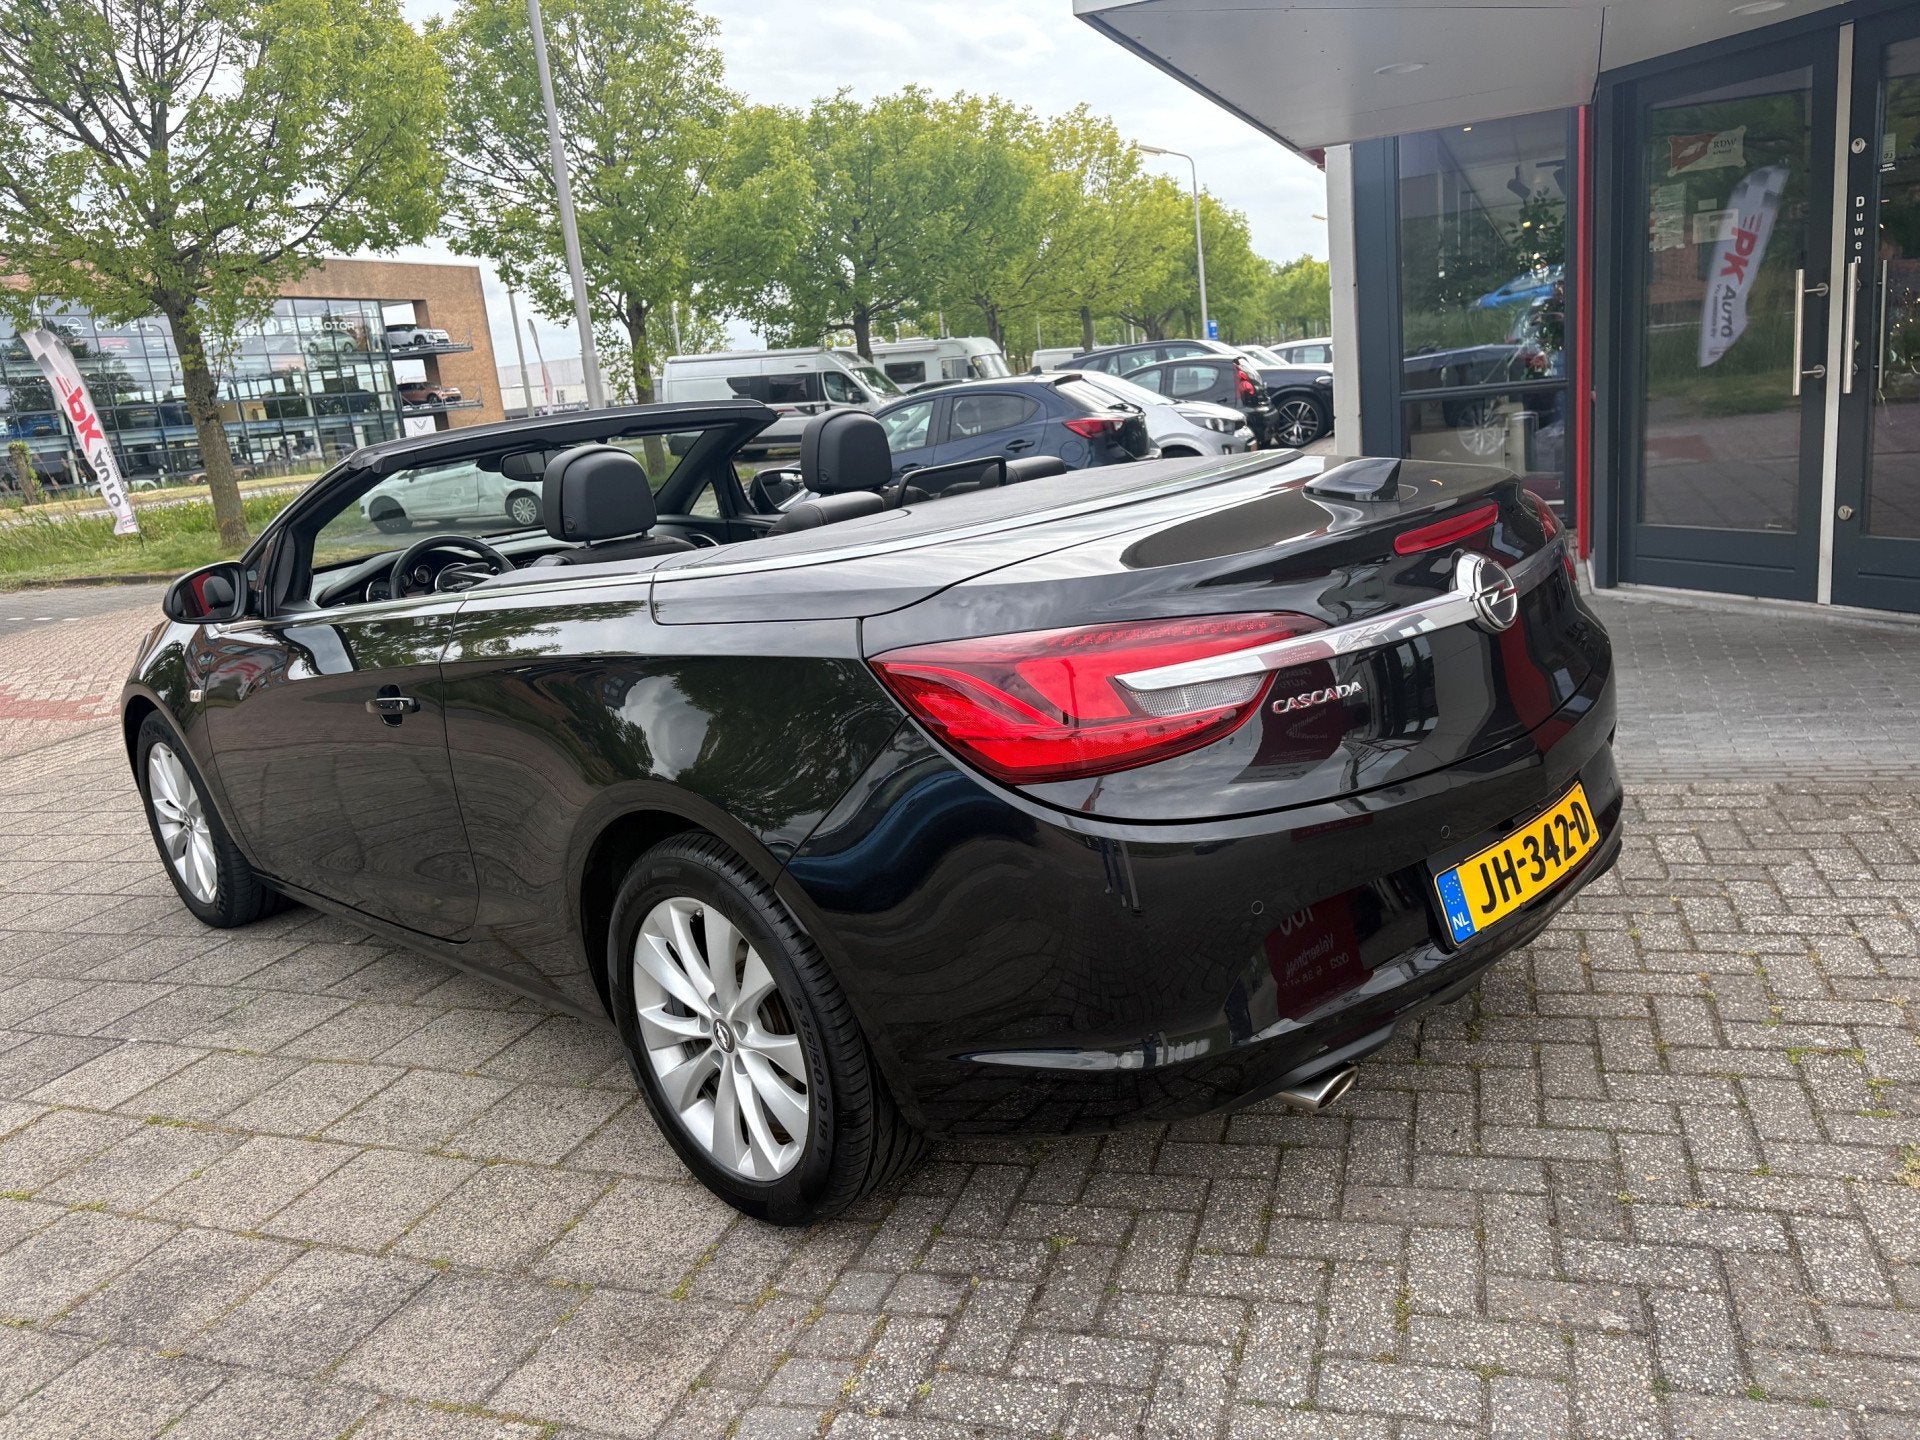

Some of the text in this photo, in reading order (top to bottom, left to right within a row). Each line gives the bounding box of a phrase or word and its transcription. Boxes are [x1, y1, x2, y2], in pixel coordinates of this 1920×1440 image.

[1713, 138, 1737, 150] RDW
[1720, 227, 1758, 286] PK
[1854, 195, 1865, 264] Duwen
[1721, 284, 1737, 339] AUTO
[1272, 680, 1364, 715] CASCADA
[1479, 801, 1590, 914] JH-342-D
[1451, 911, 1470, 931] NL
